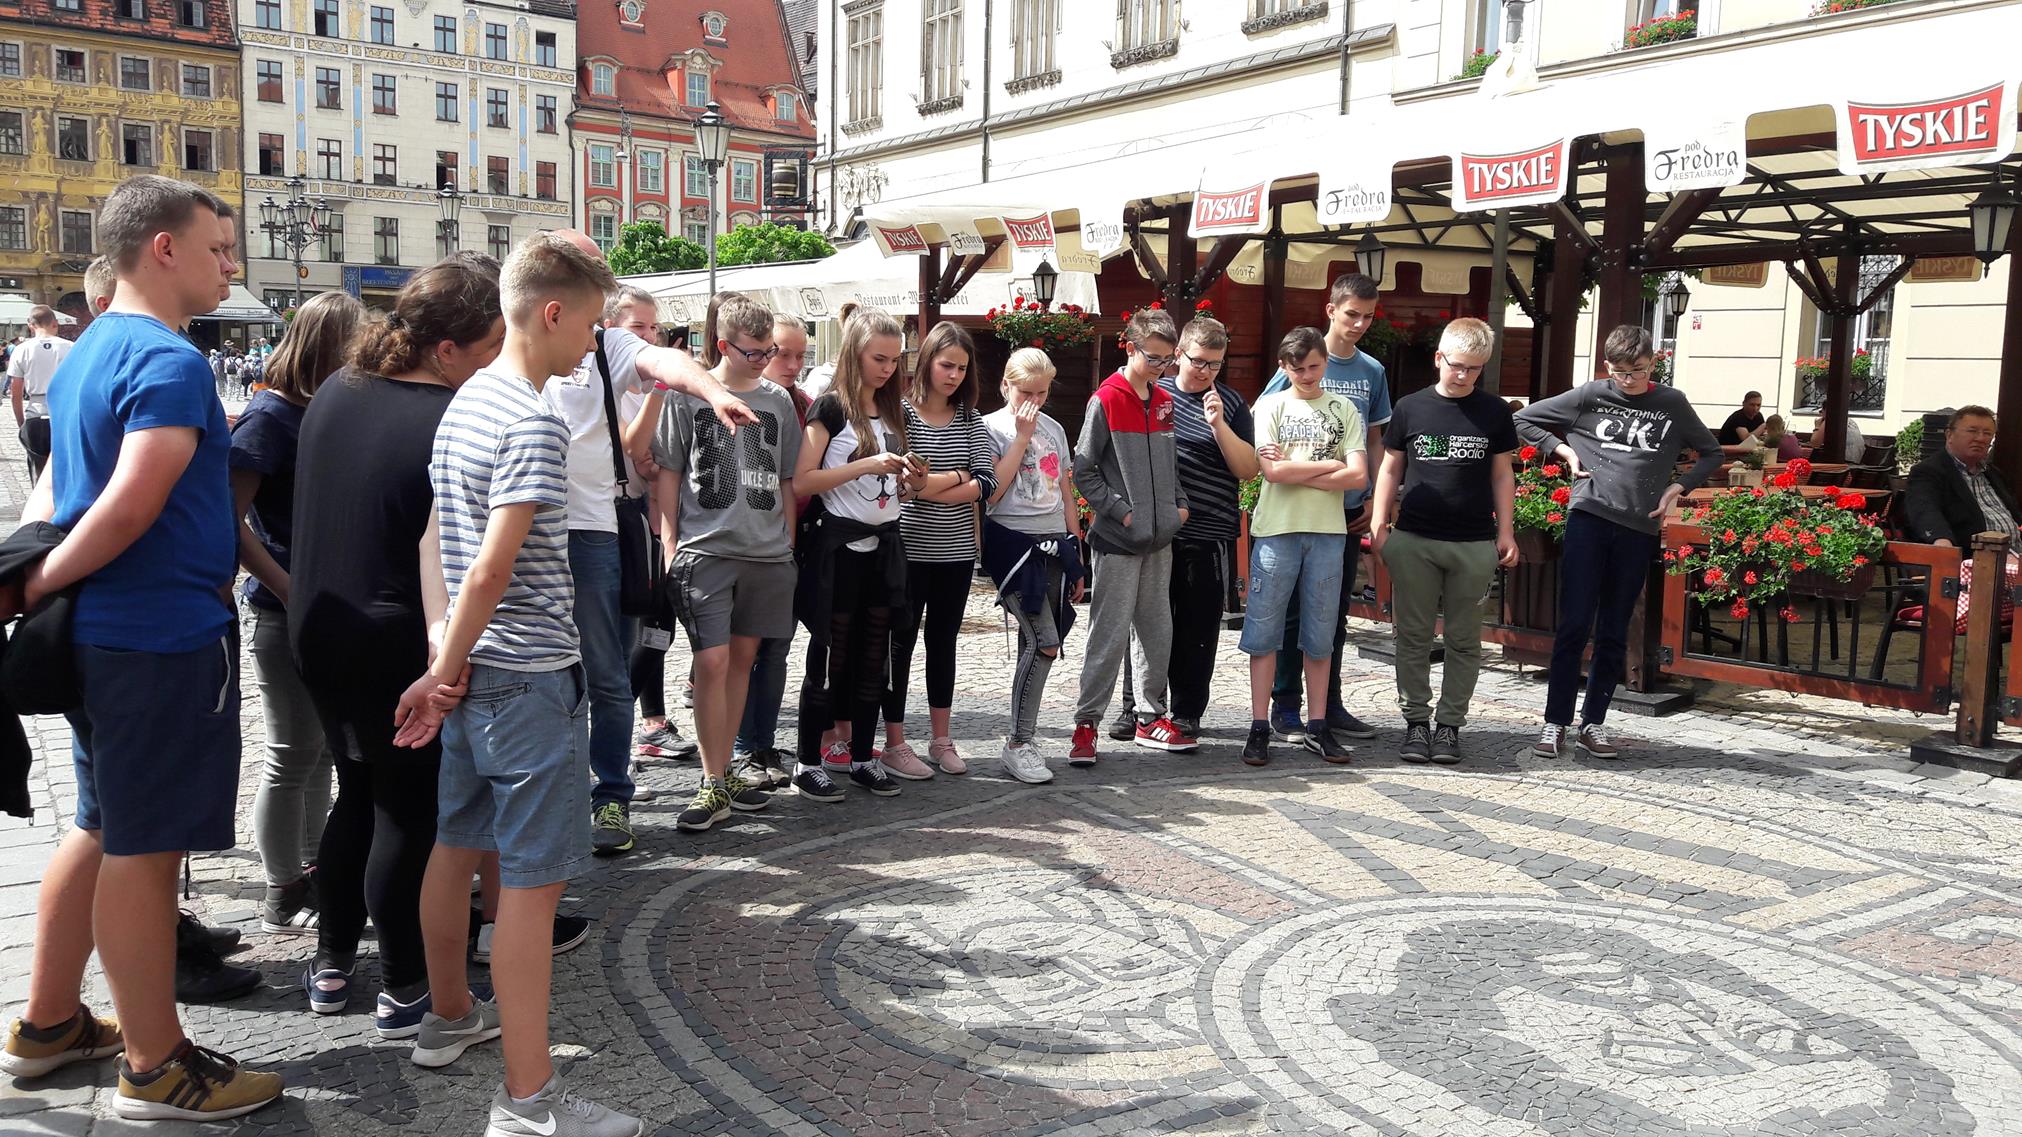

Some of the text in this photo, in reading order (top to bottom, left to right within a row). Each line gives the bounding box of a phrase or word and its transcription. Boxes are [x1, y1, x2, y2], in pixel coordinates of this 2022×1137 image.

[1859, 98, 1990, 152] TYSKIE
[1685, 140, 1701, 154] pod
[1468, 151, 1555, 193] TYSKIE
[1654, 145, 1739, 181] Fredra
[1673, 168, 1735, 181] RESTAURACJA
[1200, 190, 1257, 223] TYSKIE
[1325, 185, 1385, 216] Fredra
[884, 229, 922, 247] TYSKIE
[1009, 220, 1052, 242] TYSKIE
[1085, 222, 1120, 244] Fredra
[1597, 406, 1668, 420] EVERYTHING
[1279, 424, 1321, 441] ACADEM
